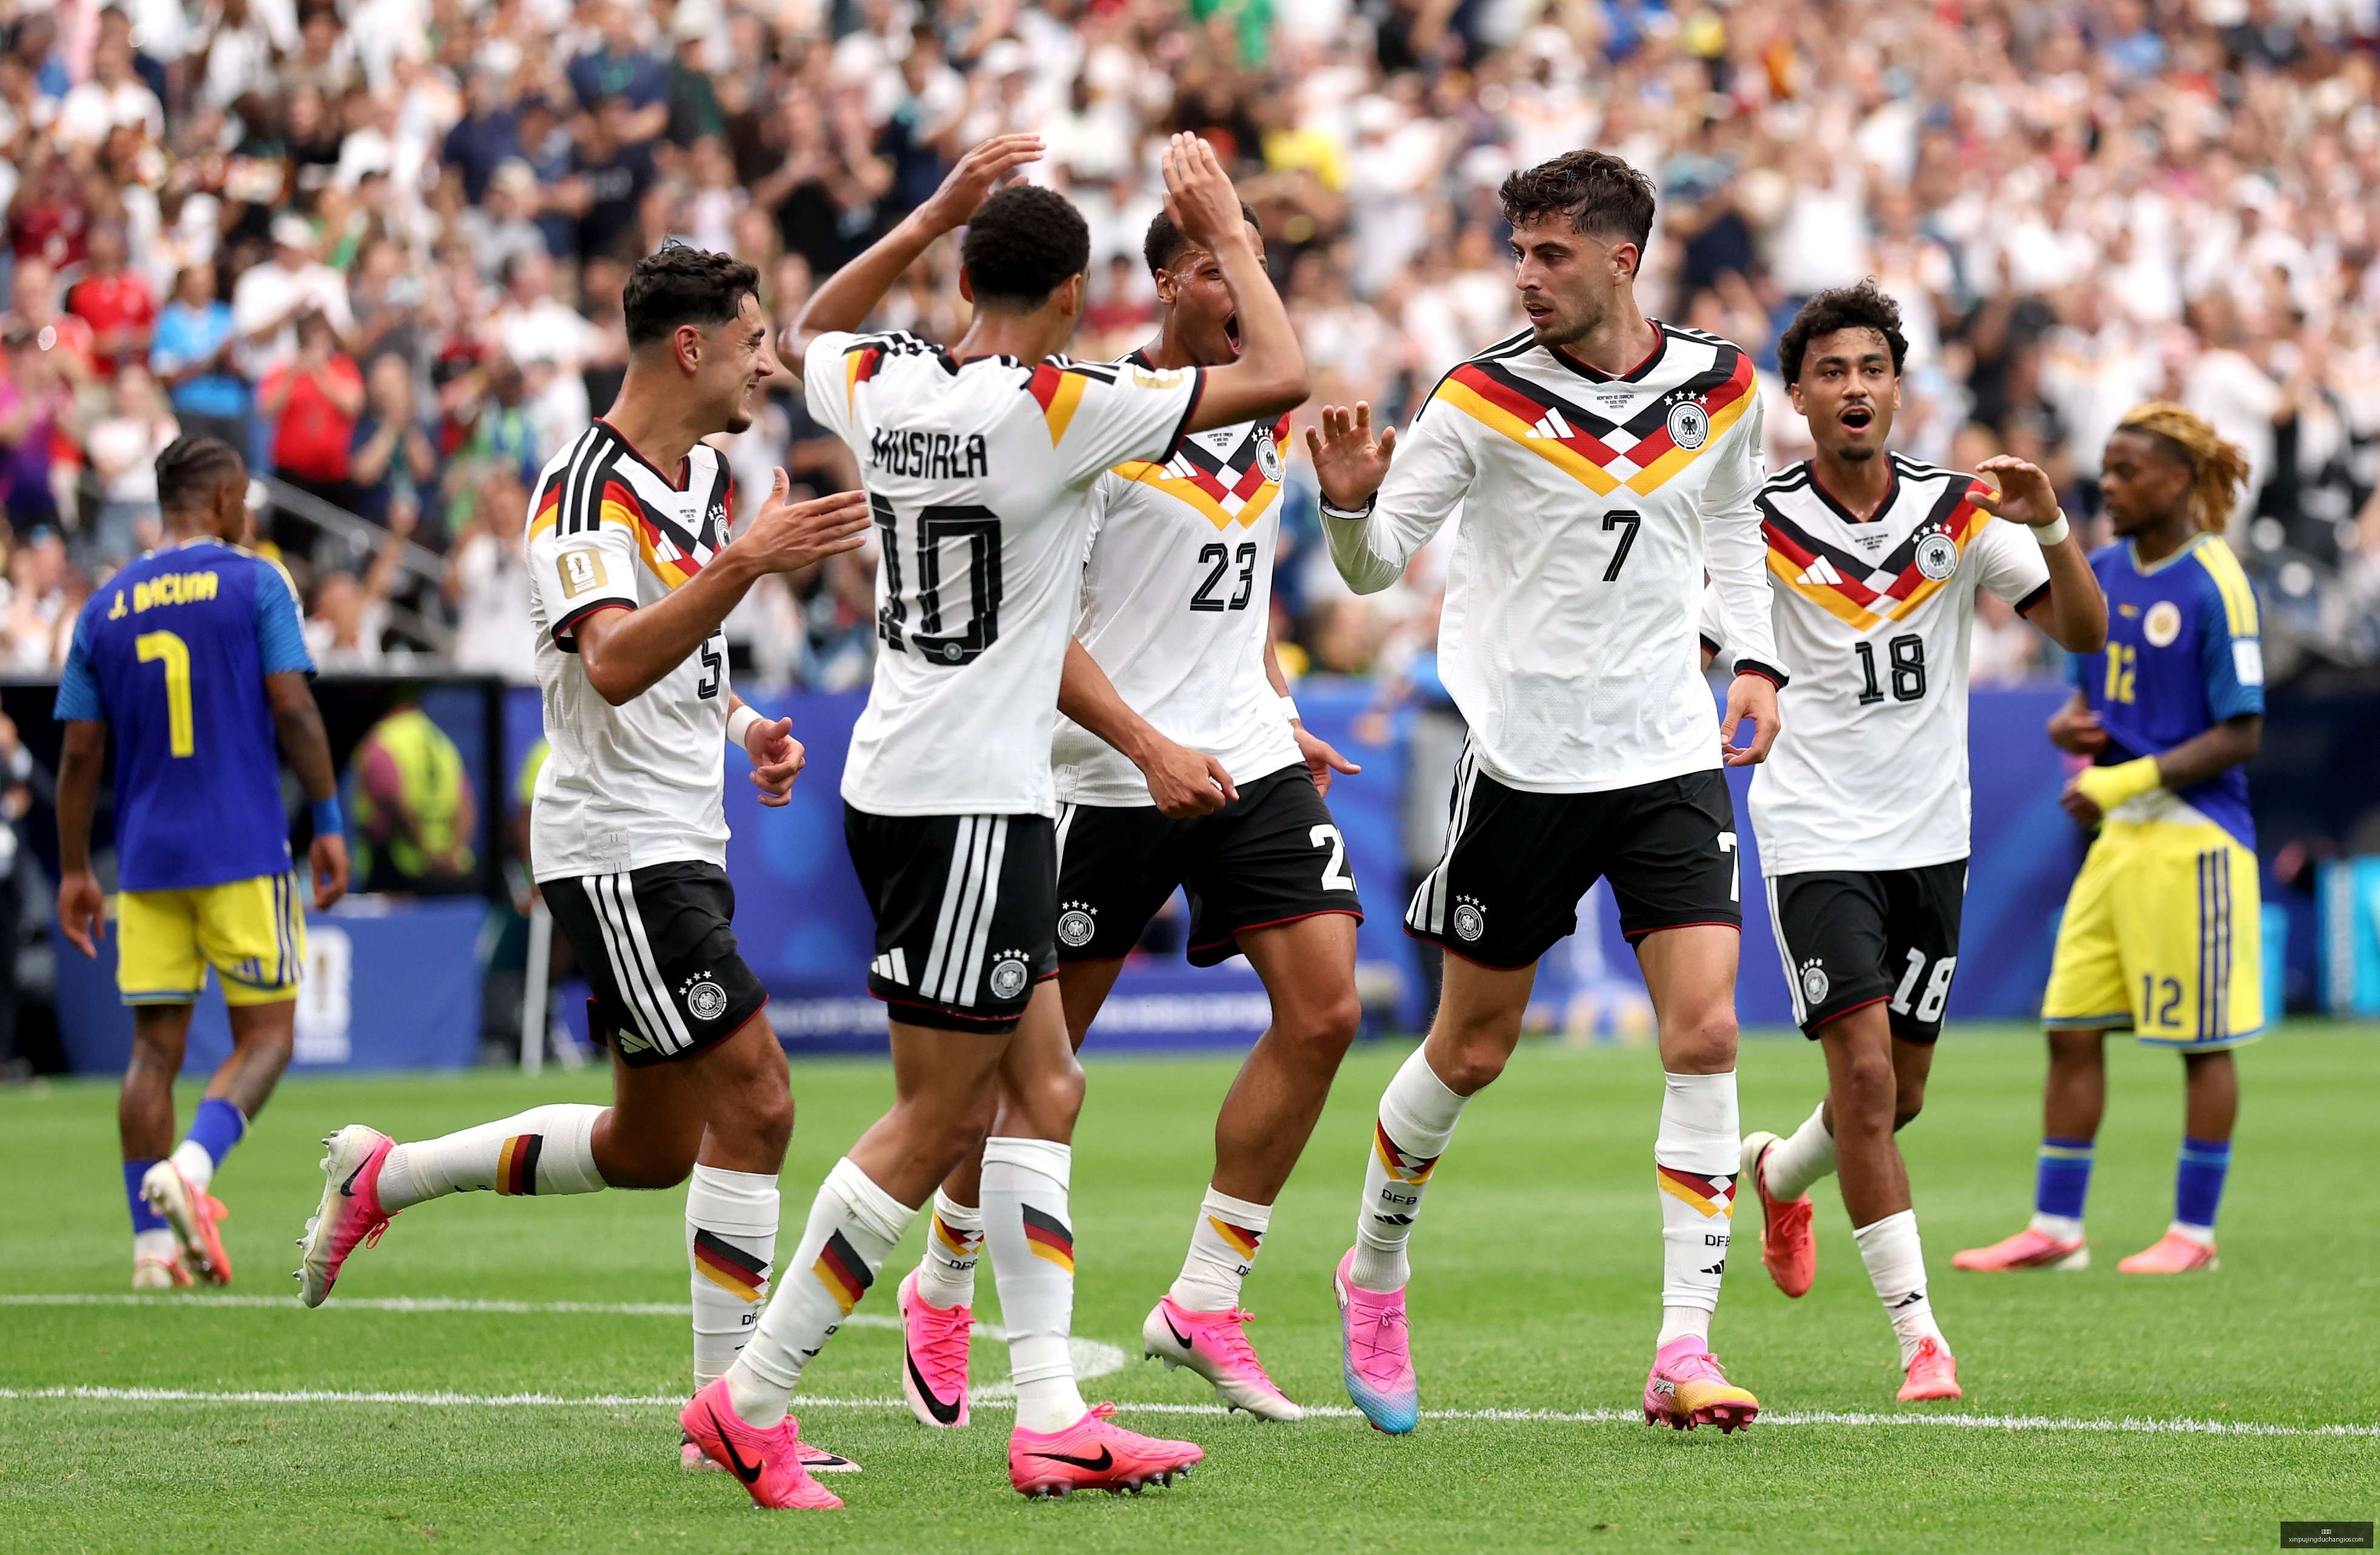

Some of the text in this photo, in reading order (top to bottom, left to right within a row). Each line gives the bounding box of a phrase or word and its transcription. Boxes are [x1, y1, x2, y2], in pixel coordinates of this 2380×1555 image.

[1676, 409, 1699, 418] DEUTSCHER
[870, 426, 989, 480] MUSIALA
[870, 492, 1003, 666] 10
[1189, 542, 1257, 611] 23
[1602, 509, 1641, 582] 7
[135, 629, 195, 758] 7
[698, 620, 722, 700] 5
[1855, 634, 1926, 706] 18
[1309, 824, 1359, 896] 2
[1716, 831, 1740, 902] 7
[1888, 947, 1957, 1023] 18
[2142, 974, 2182, 1027] 12
[1382, 1188, 1417, 1205] DFB
